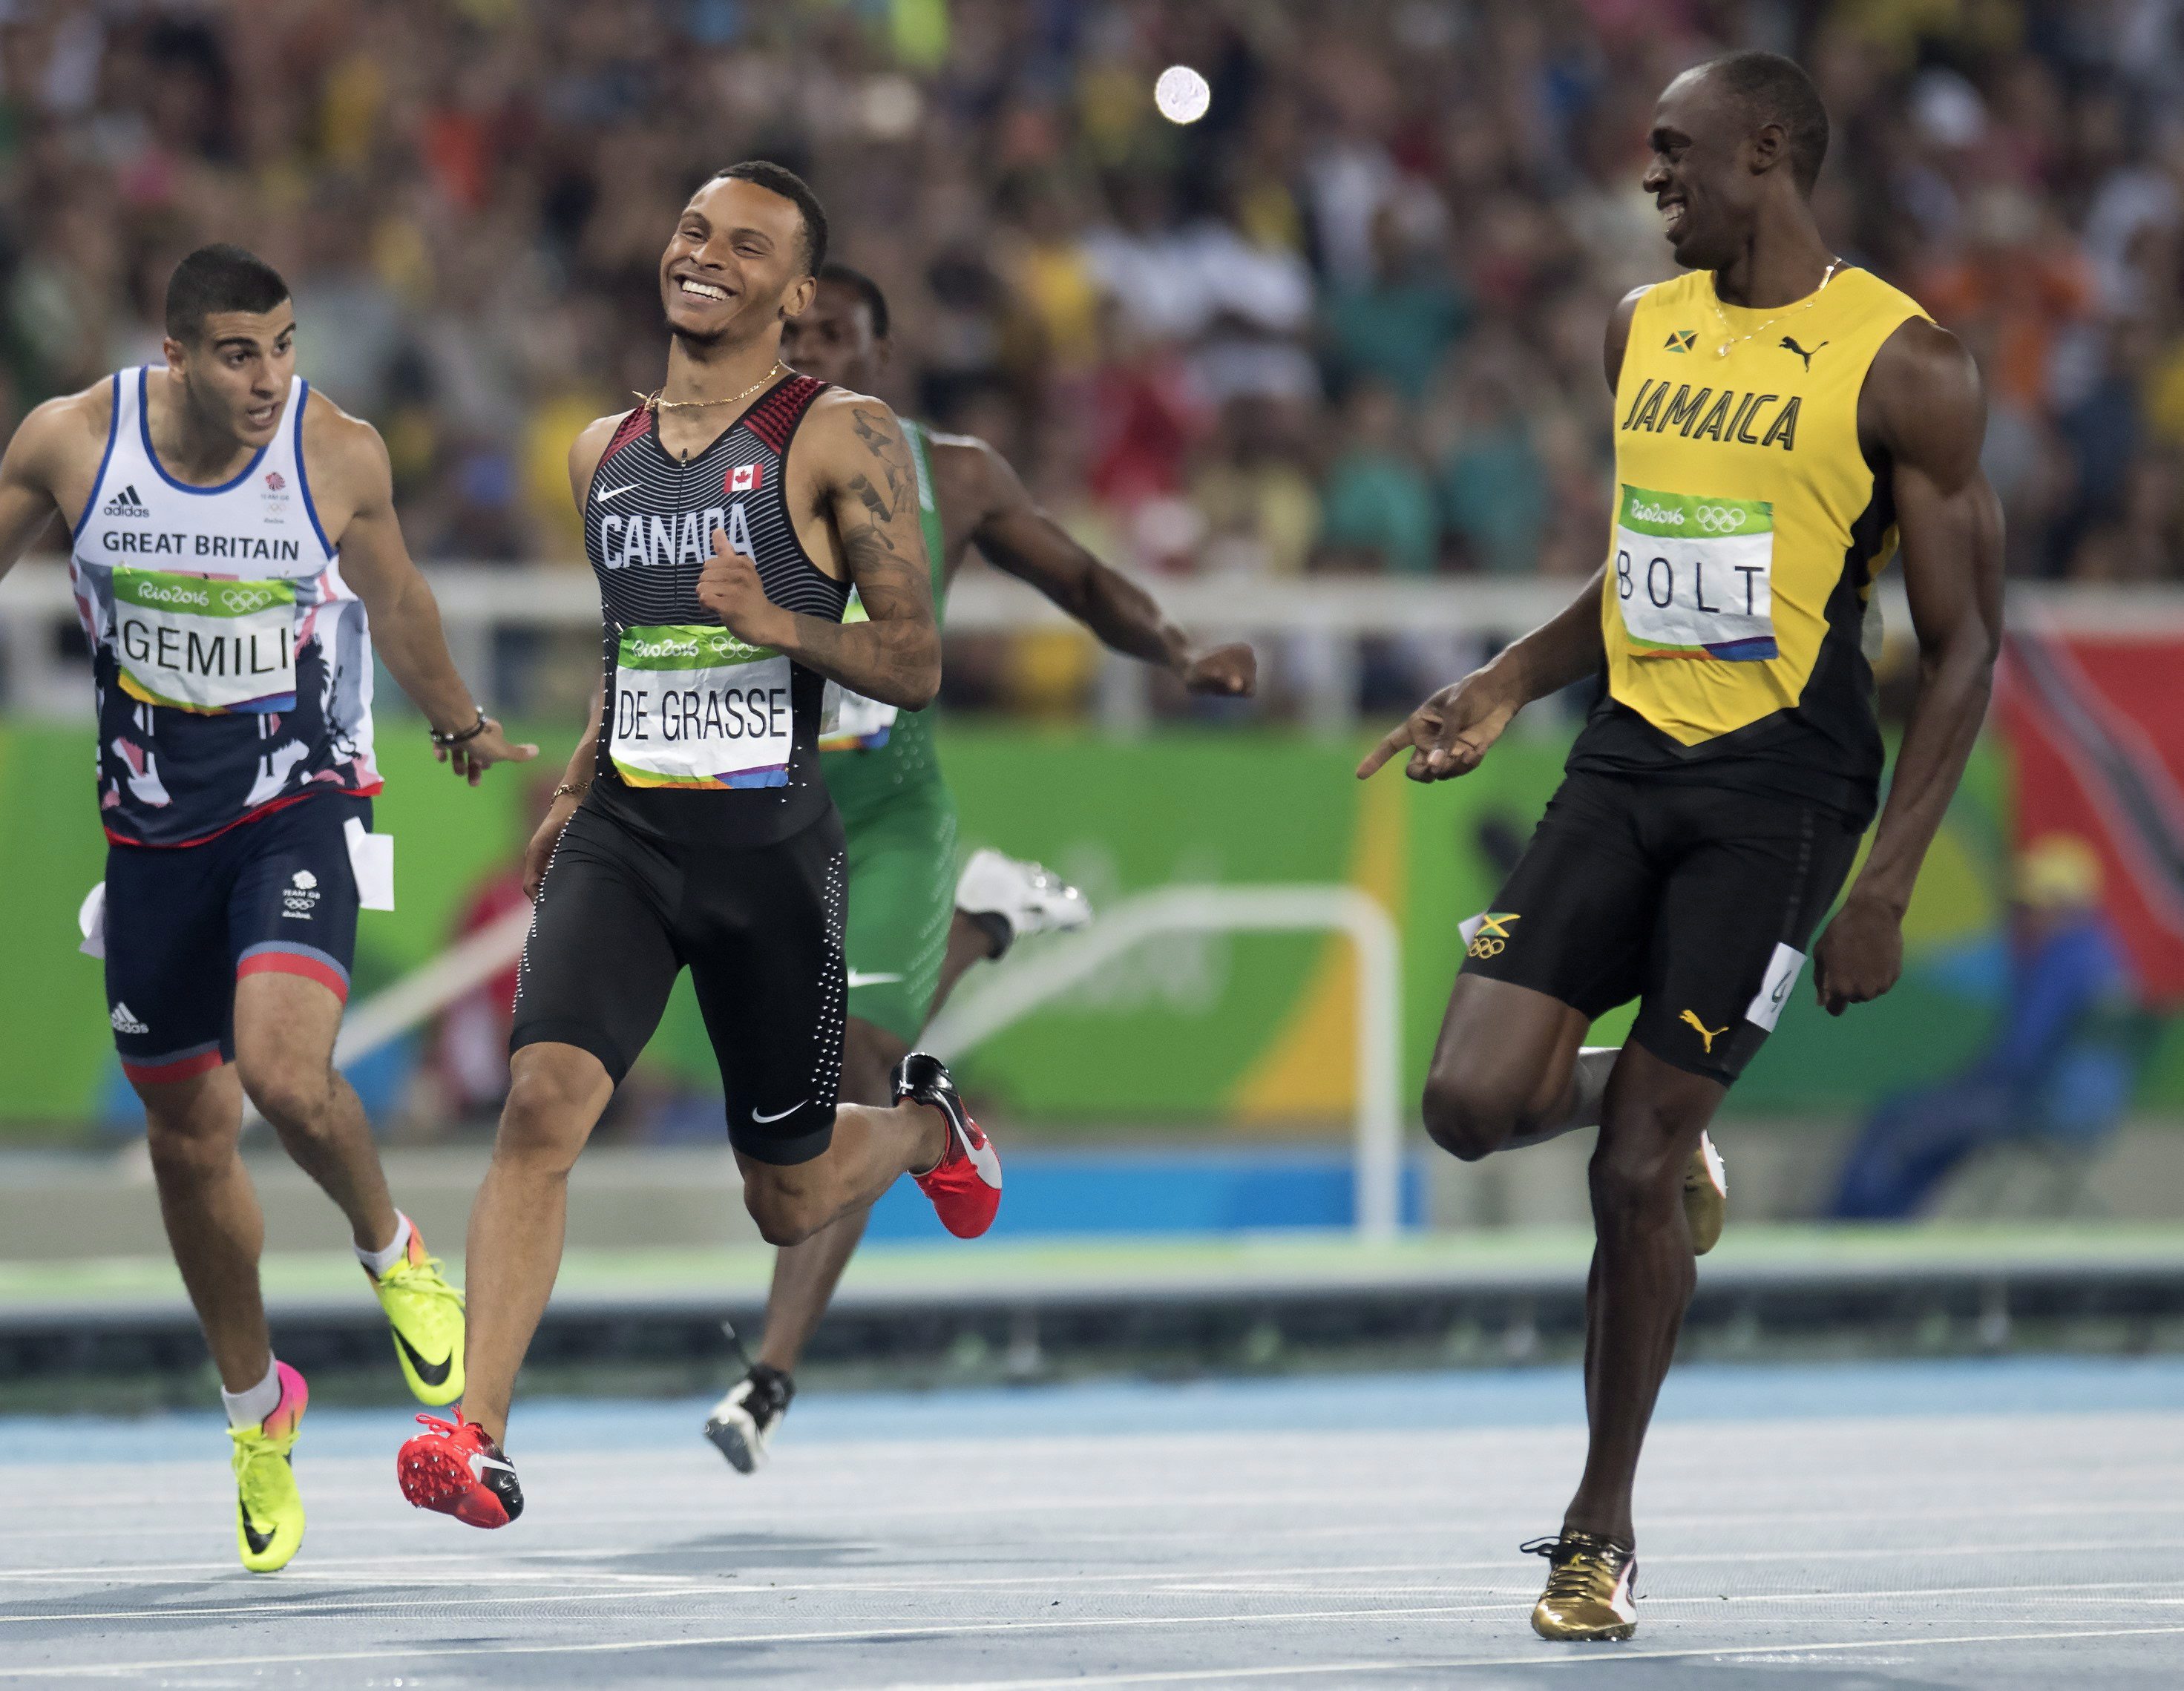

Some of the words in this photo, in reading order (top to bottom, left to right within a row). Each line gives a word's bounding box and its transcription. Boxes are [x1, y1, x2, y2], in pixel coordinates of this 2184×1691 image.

[1621, 378, 1803, 451] JAMAICA
[104, 505, 149, 517] adidas
[1632, 499, 1685, 525] Rio2016
[102, 531, 186, 554] GREAT
[195, 535, 299, 561] BRITAIN
[601, 503, 757, 569] CANADA
[139, 581, 210, 607] Rio2016
[1617, 549, 1765, 616] BOLT
[123, 620, 286, 677] GEMILI
[632, 639, 699, 657] Rio2016
[618, 690, 649, 740] DE
[662, 689, 787, 741] GRASSE
